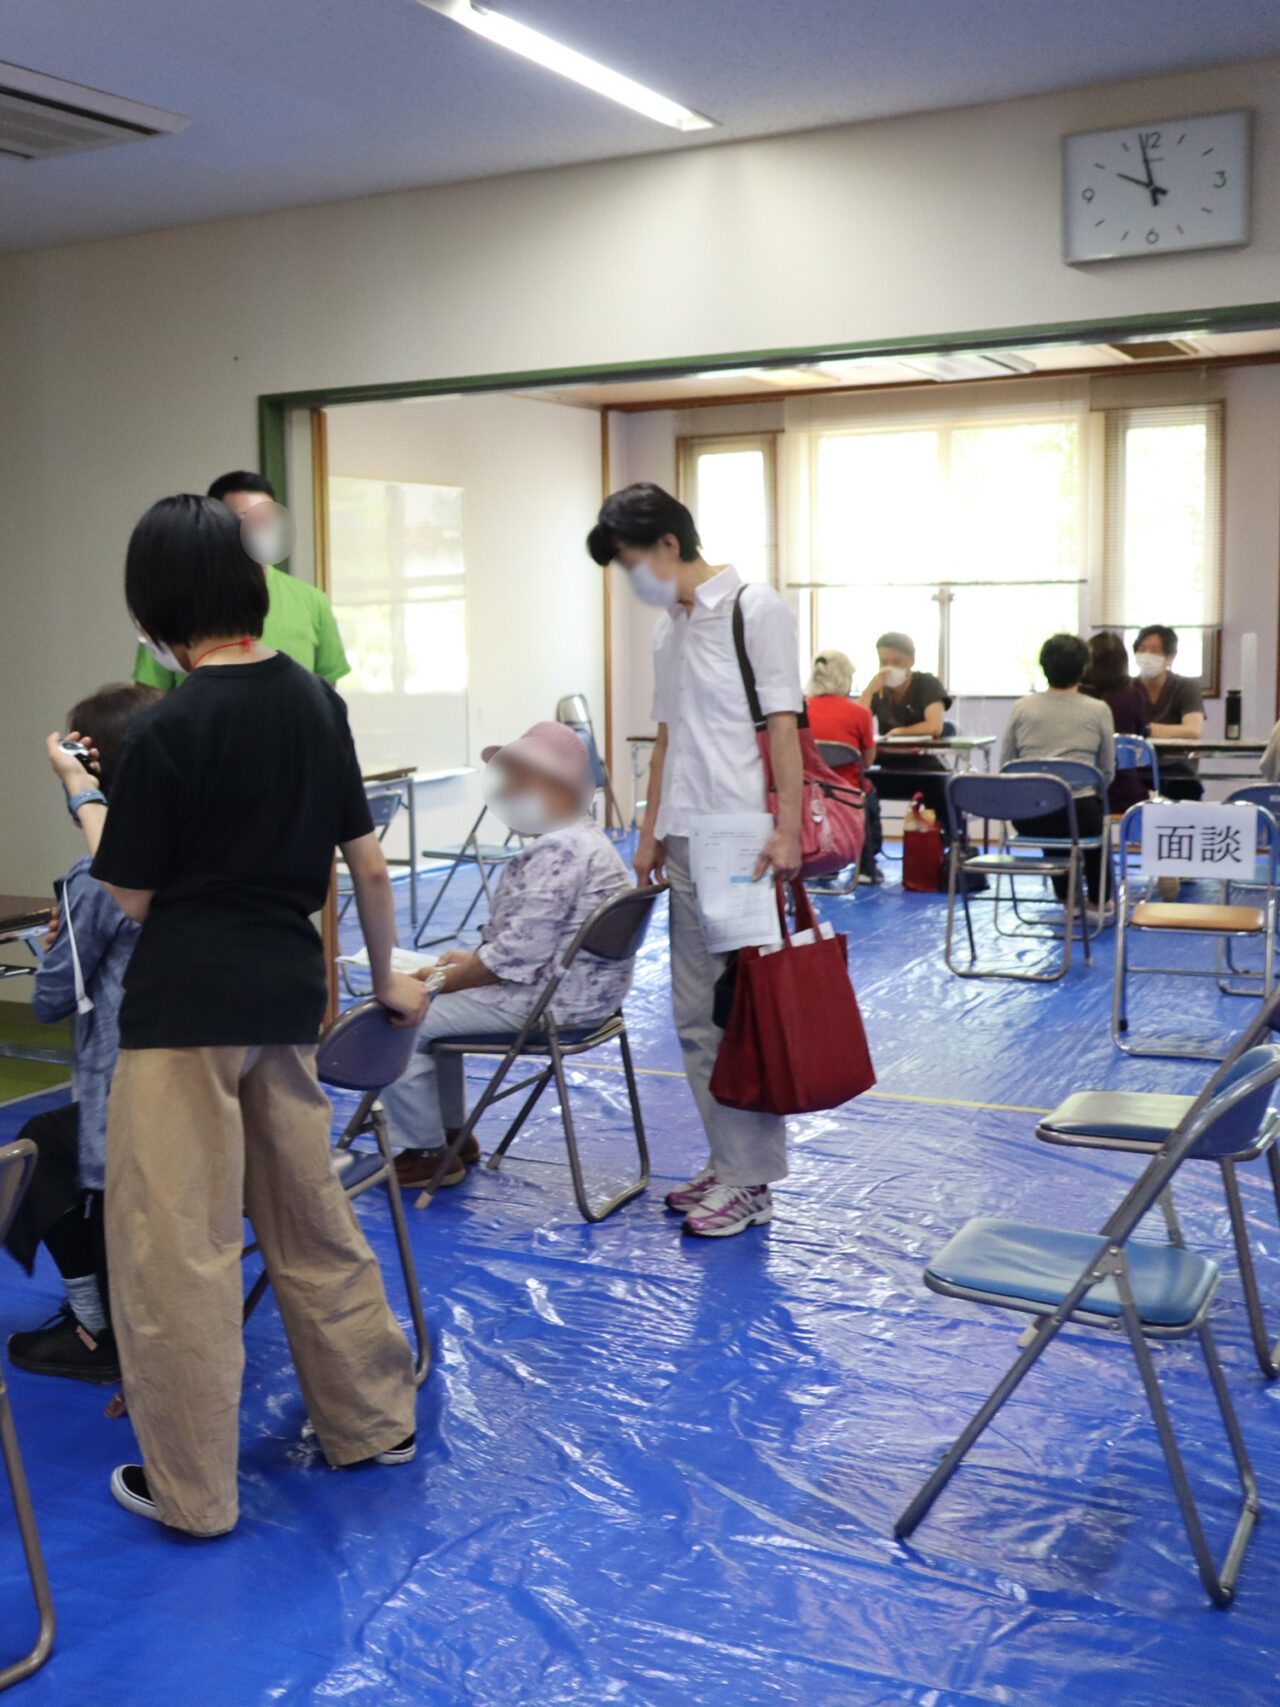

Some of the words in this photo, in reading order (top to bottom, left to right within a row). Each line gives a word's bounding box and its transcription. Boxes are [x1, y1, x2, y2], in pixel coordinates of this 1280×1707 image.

[1144, 131, 1162, 149] 12
[1212, 170, 1227, 189] 3
[1081, 187, 1096, 205] 9
[1145, 228, 1160, 245] 6
[1155, 825, 1243, 864] 面談
